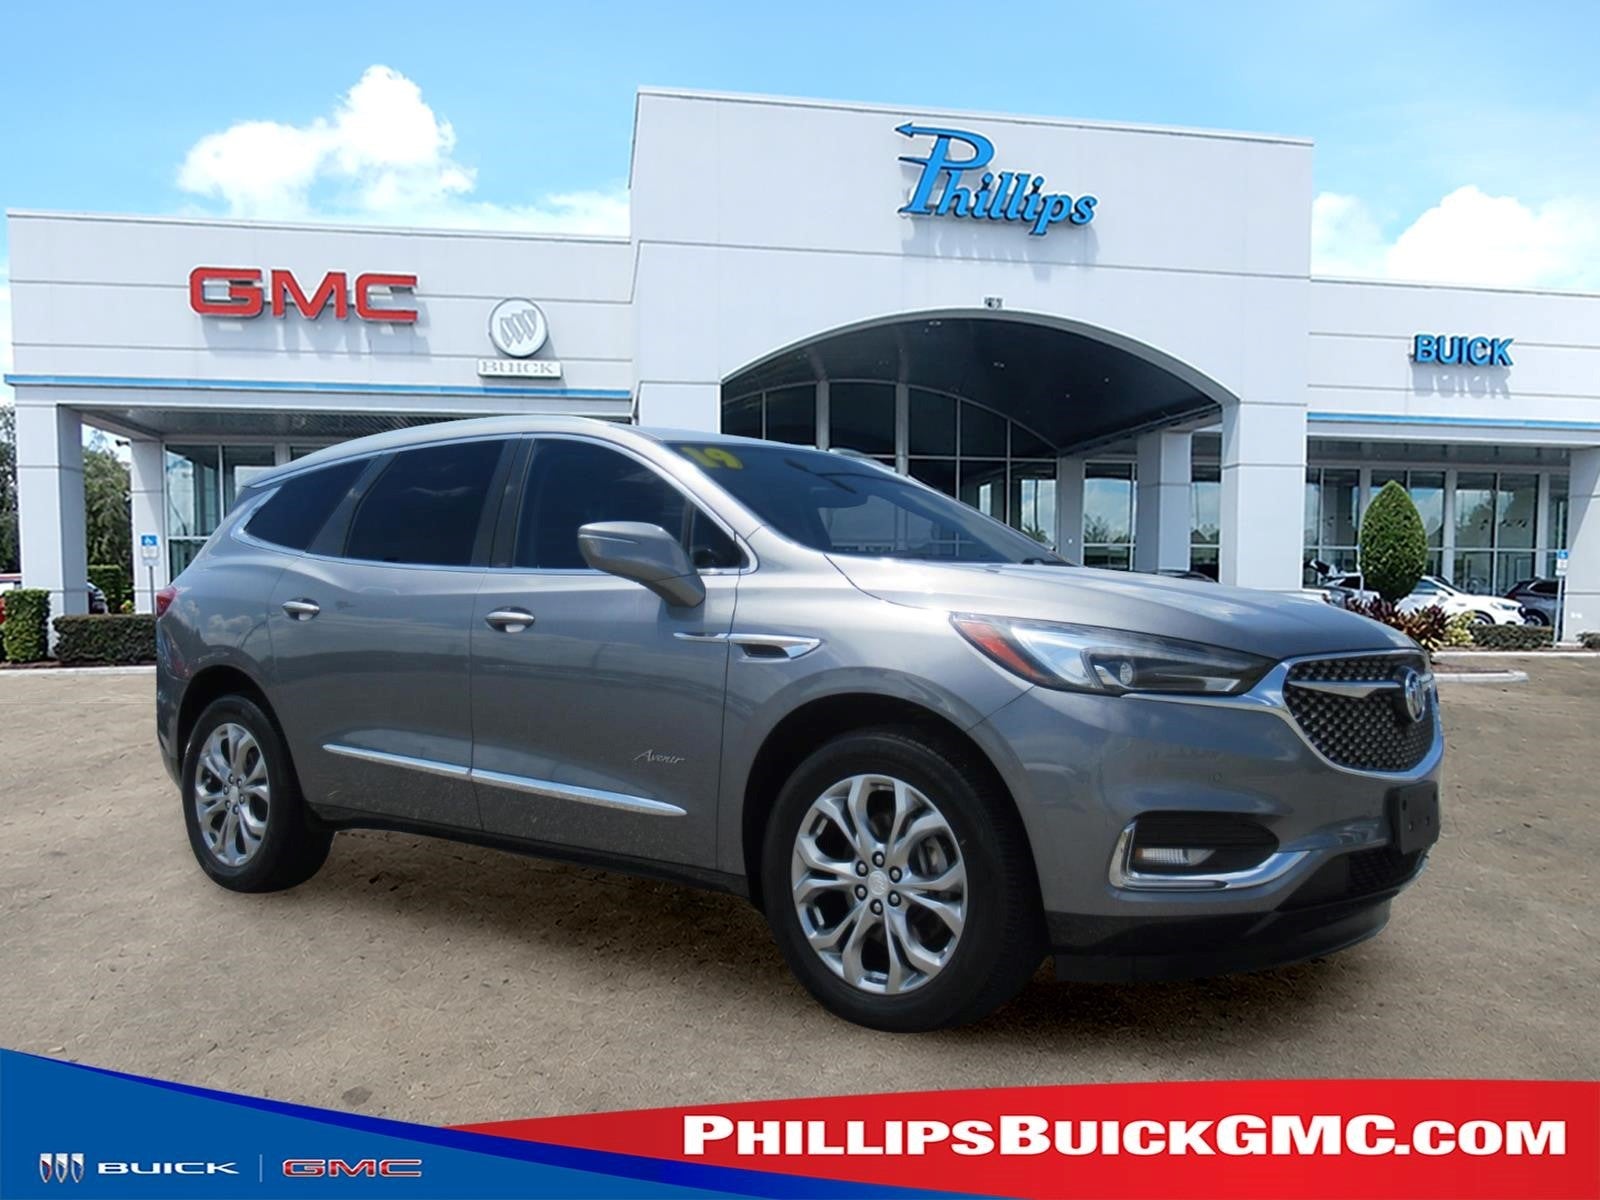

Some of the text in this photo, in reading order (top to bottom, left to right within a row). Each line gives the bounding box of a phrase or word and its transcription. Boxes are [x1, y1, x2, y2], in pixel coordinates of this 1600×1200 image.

[894, 122, 1098, 235] Phillips
[190, 267, 418, 324] GMC
[481, 361, 554, 374] BUICK
[1413, 334, 1514, 366] BUICK
